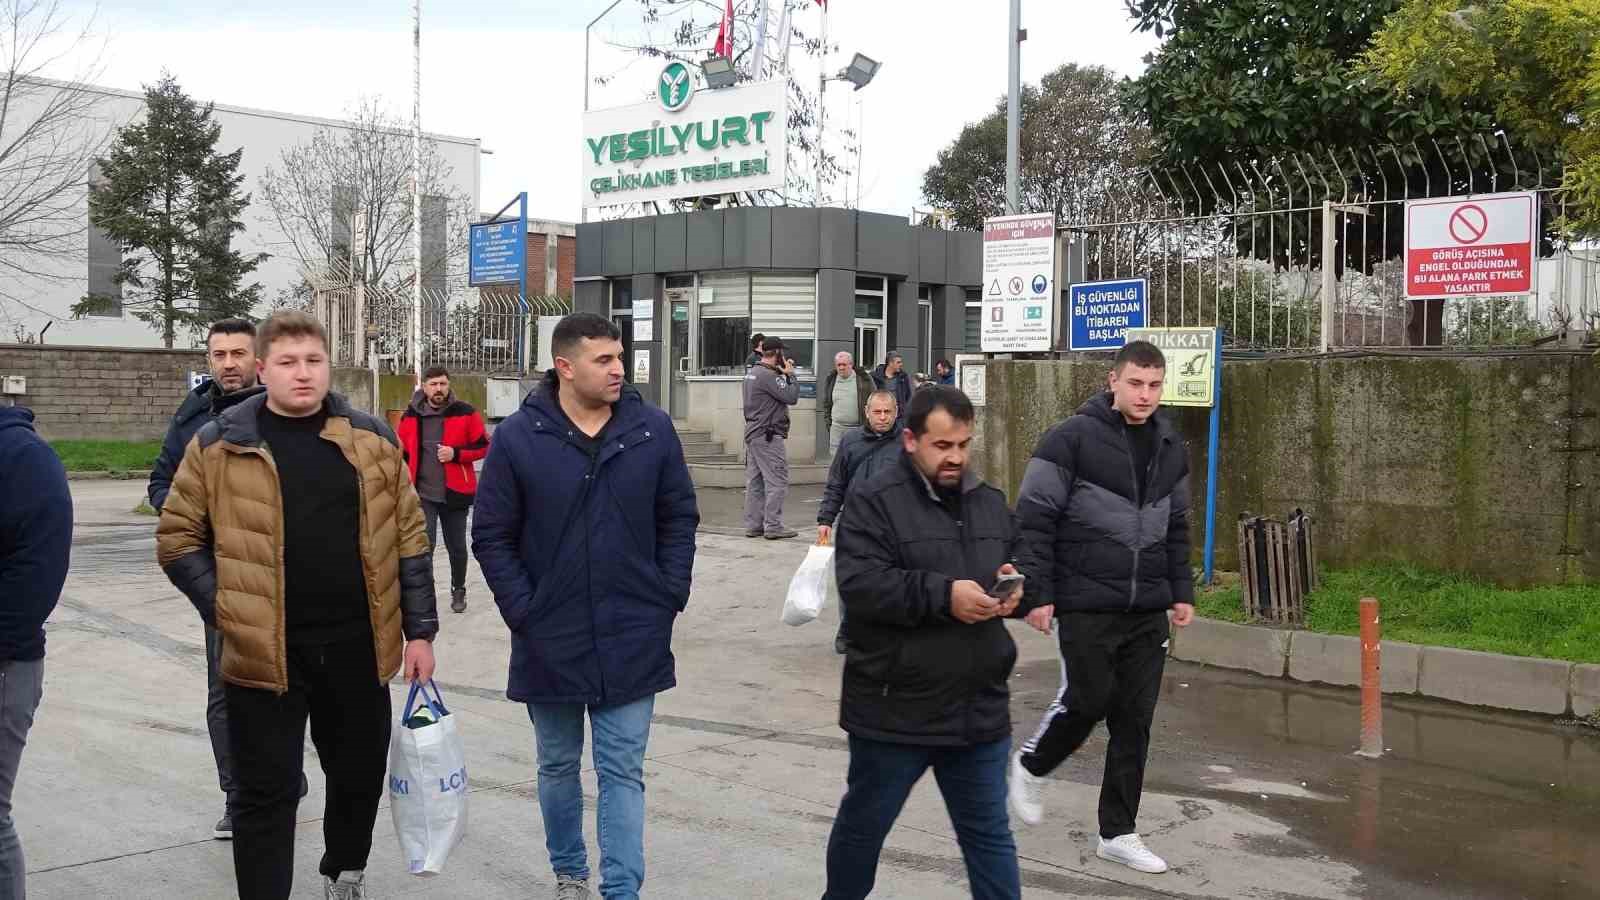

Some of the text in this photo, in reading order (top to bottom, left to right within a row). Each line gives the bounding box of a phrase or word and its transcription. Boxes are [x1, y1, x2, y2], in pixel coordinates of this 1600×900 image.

[587, 112, 773, 168] YEŞİLYURT
[590, 151, 770, 198] ÇELİKHANE TESİSLERİ
[1432, 247, 1505, 260] GÖRÜŞ AÇISINA
[1419, 259, 1518, 272] ENGEL OLDUĞUNDAN
[1413, 270, 1524, 284] BU ALANA PARK ETMEK
[1444, 282, 1491, 293] YASAKTIR
[1077, 288, 1137, 305] İŞ GÜVENLİĞİ
[1075, 302, 1140, 316] BU NOKTADAN
[1086, 315, 1128, 328] İTİBAREN
[1089, 328, 1127, 342] BAŞLAR
[1148, 331, 1209, 347] DİKKAT
